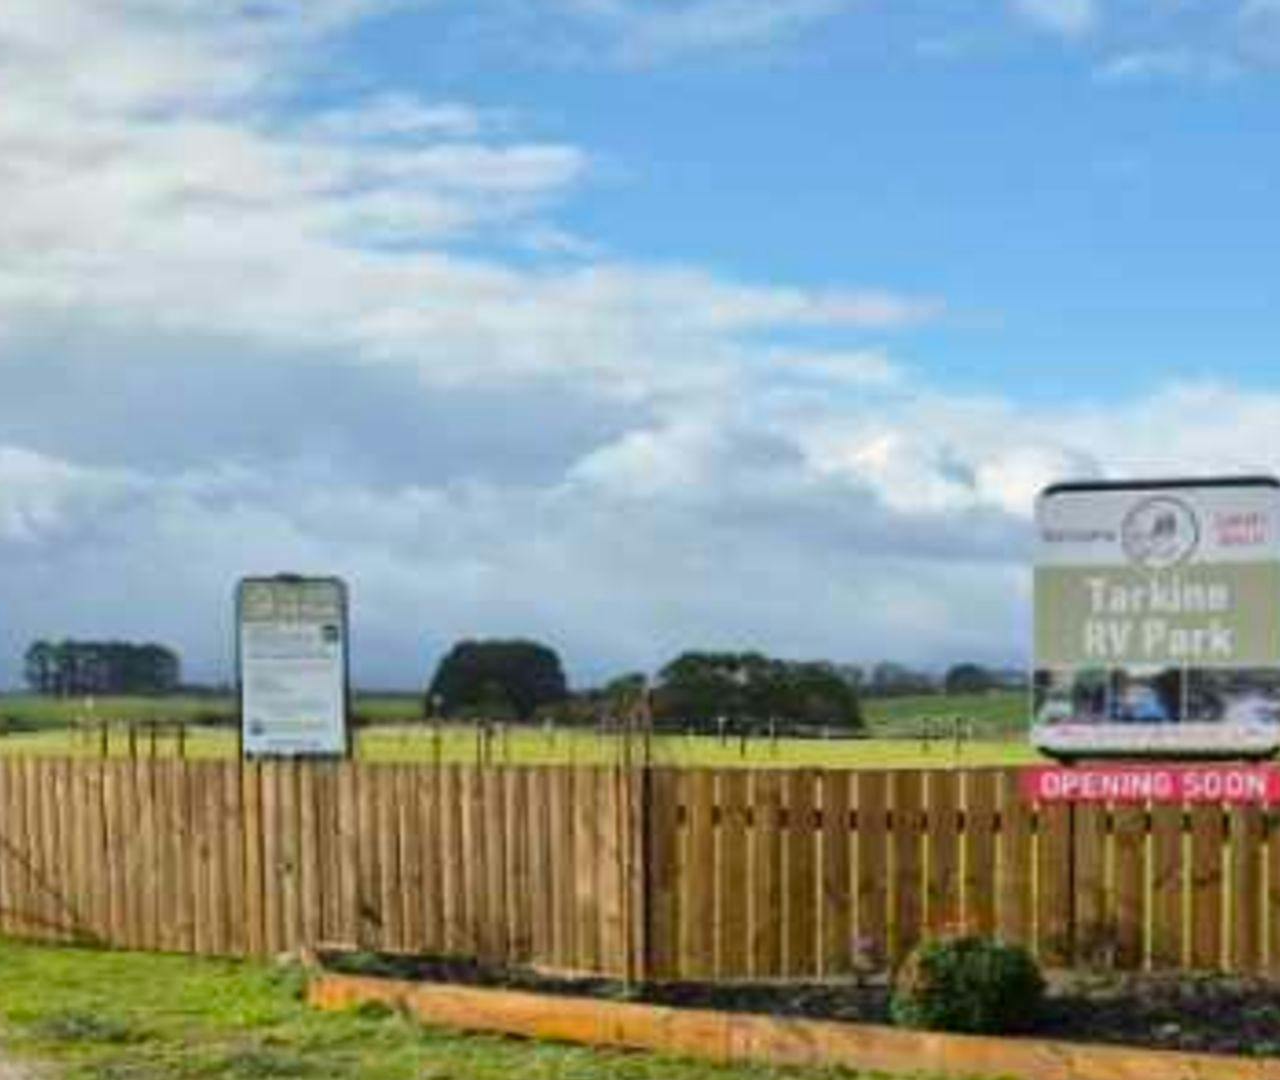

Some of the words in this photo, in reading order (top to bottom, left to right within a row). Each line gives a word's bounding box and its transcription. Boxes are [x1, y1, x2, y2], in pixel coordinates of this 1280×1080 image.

[1084, 619, 1133, 655] RV
[1143, 618, 1233, 655] Park
[1040, 770, 1175, 798] OPENING
[1182, 770, 1266, 797] SOON
